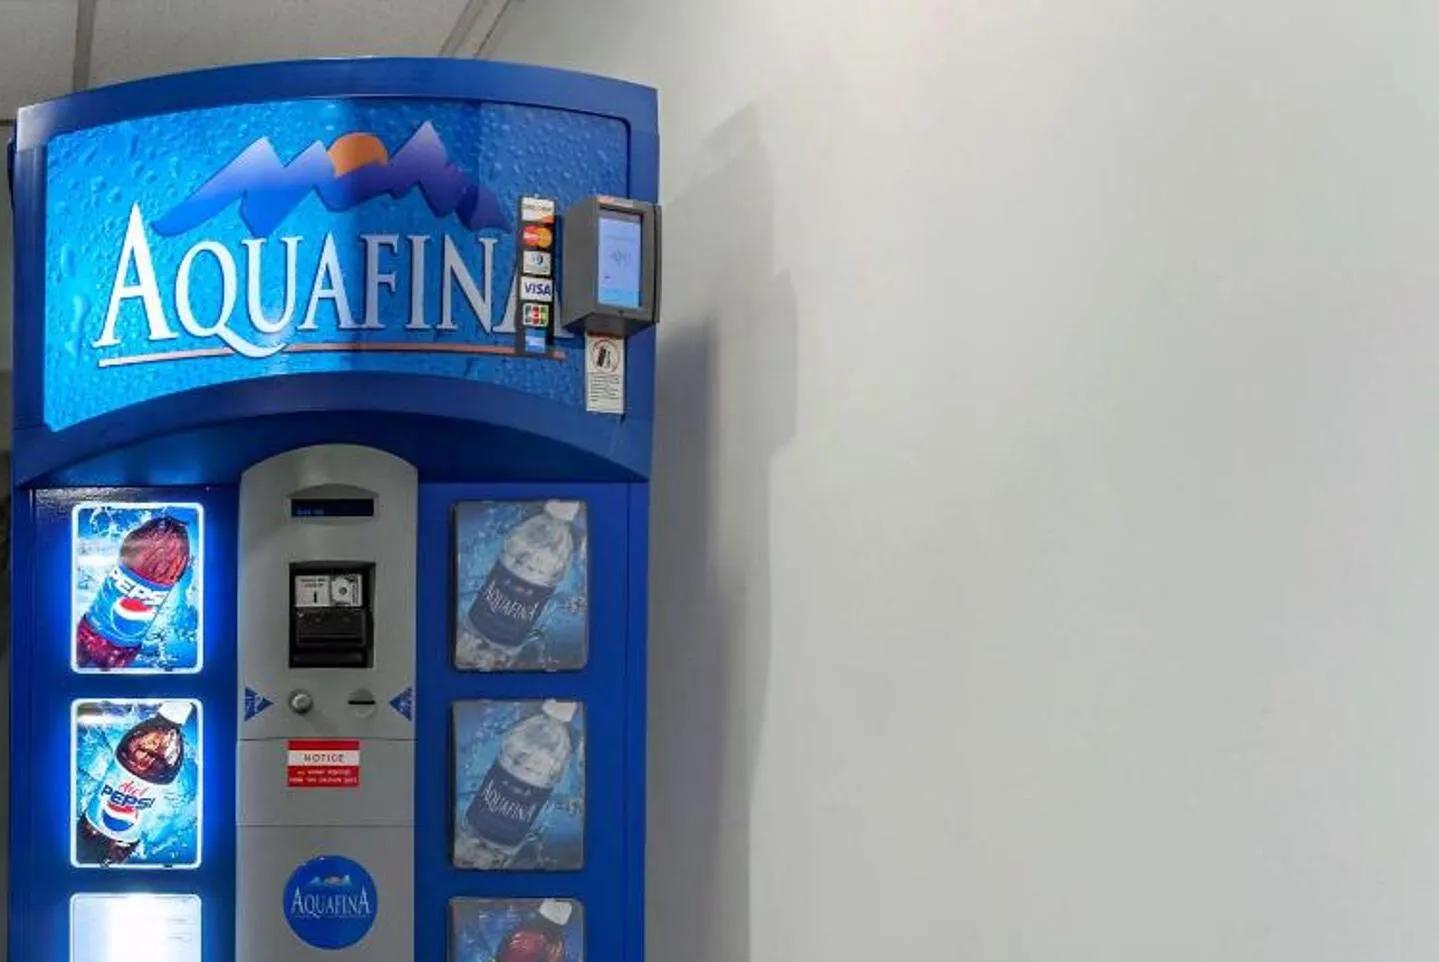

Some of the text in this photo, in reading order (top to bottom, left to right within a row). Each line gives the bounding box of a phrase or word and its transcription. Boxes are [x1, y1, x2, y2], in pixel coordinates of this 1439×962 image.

[524, 283, 552, 296] VISA
[303, 753, 345, 763] NOTICE
[101, 784, 156, 810] PEPSI
[291, 884, 371, 919] AQUAFINA
